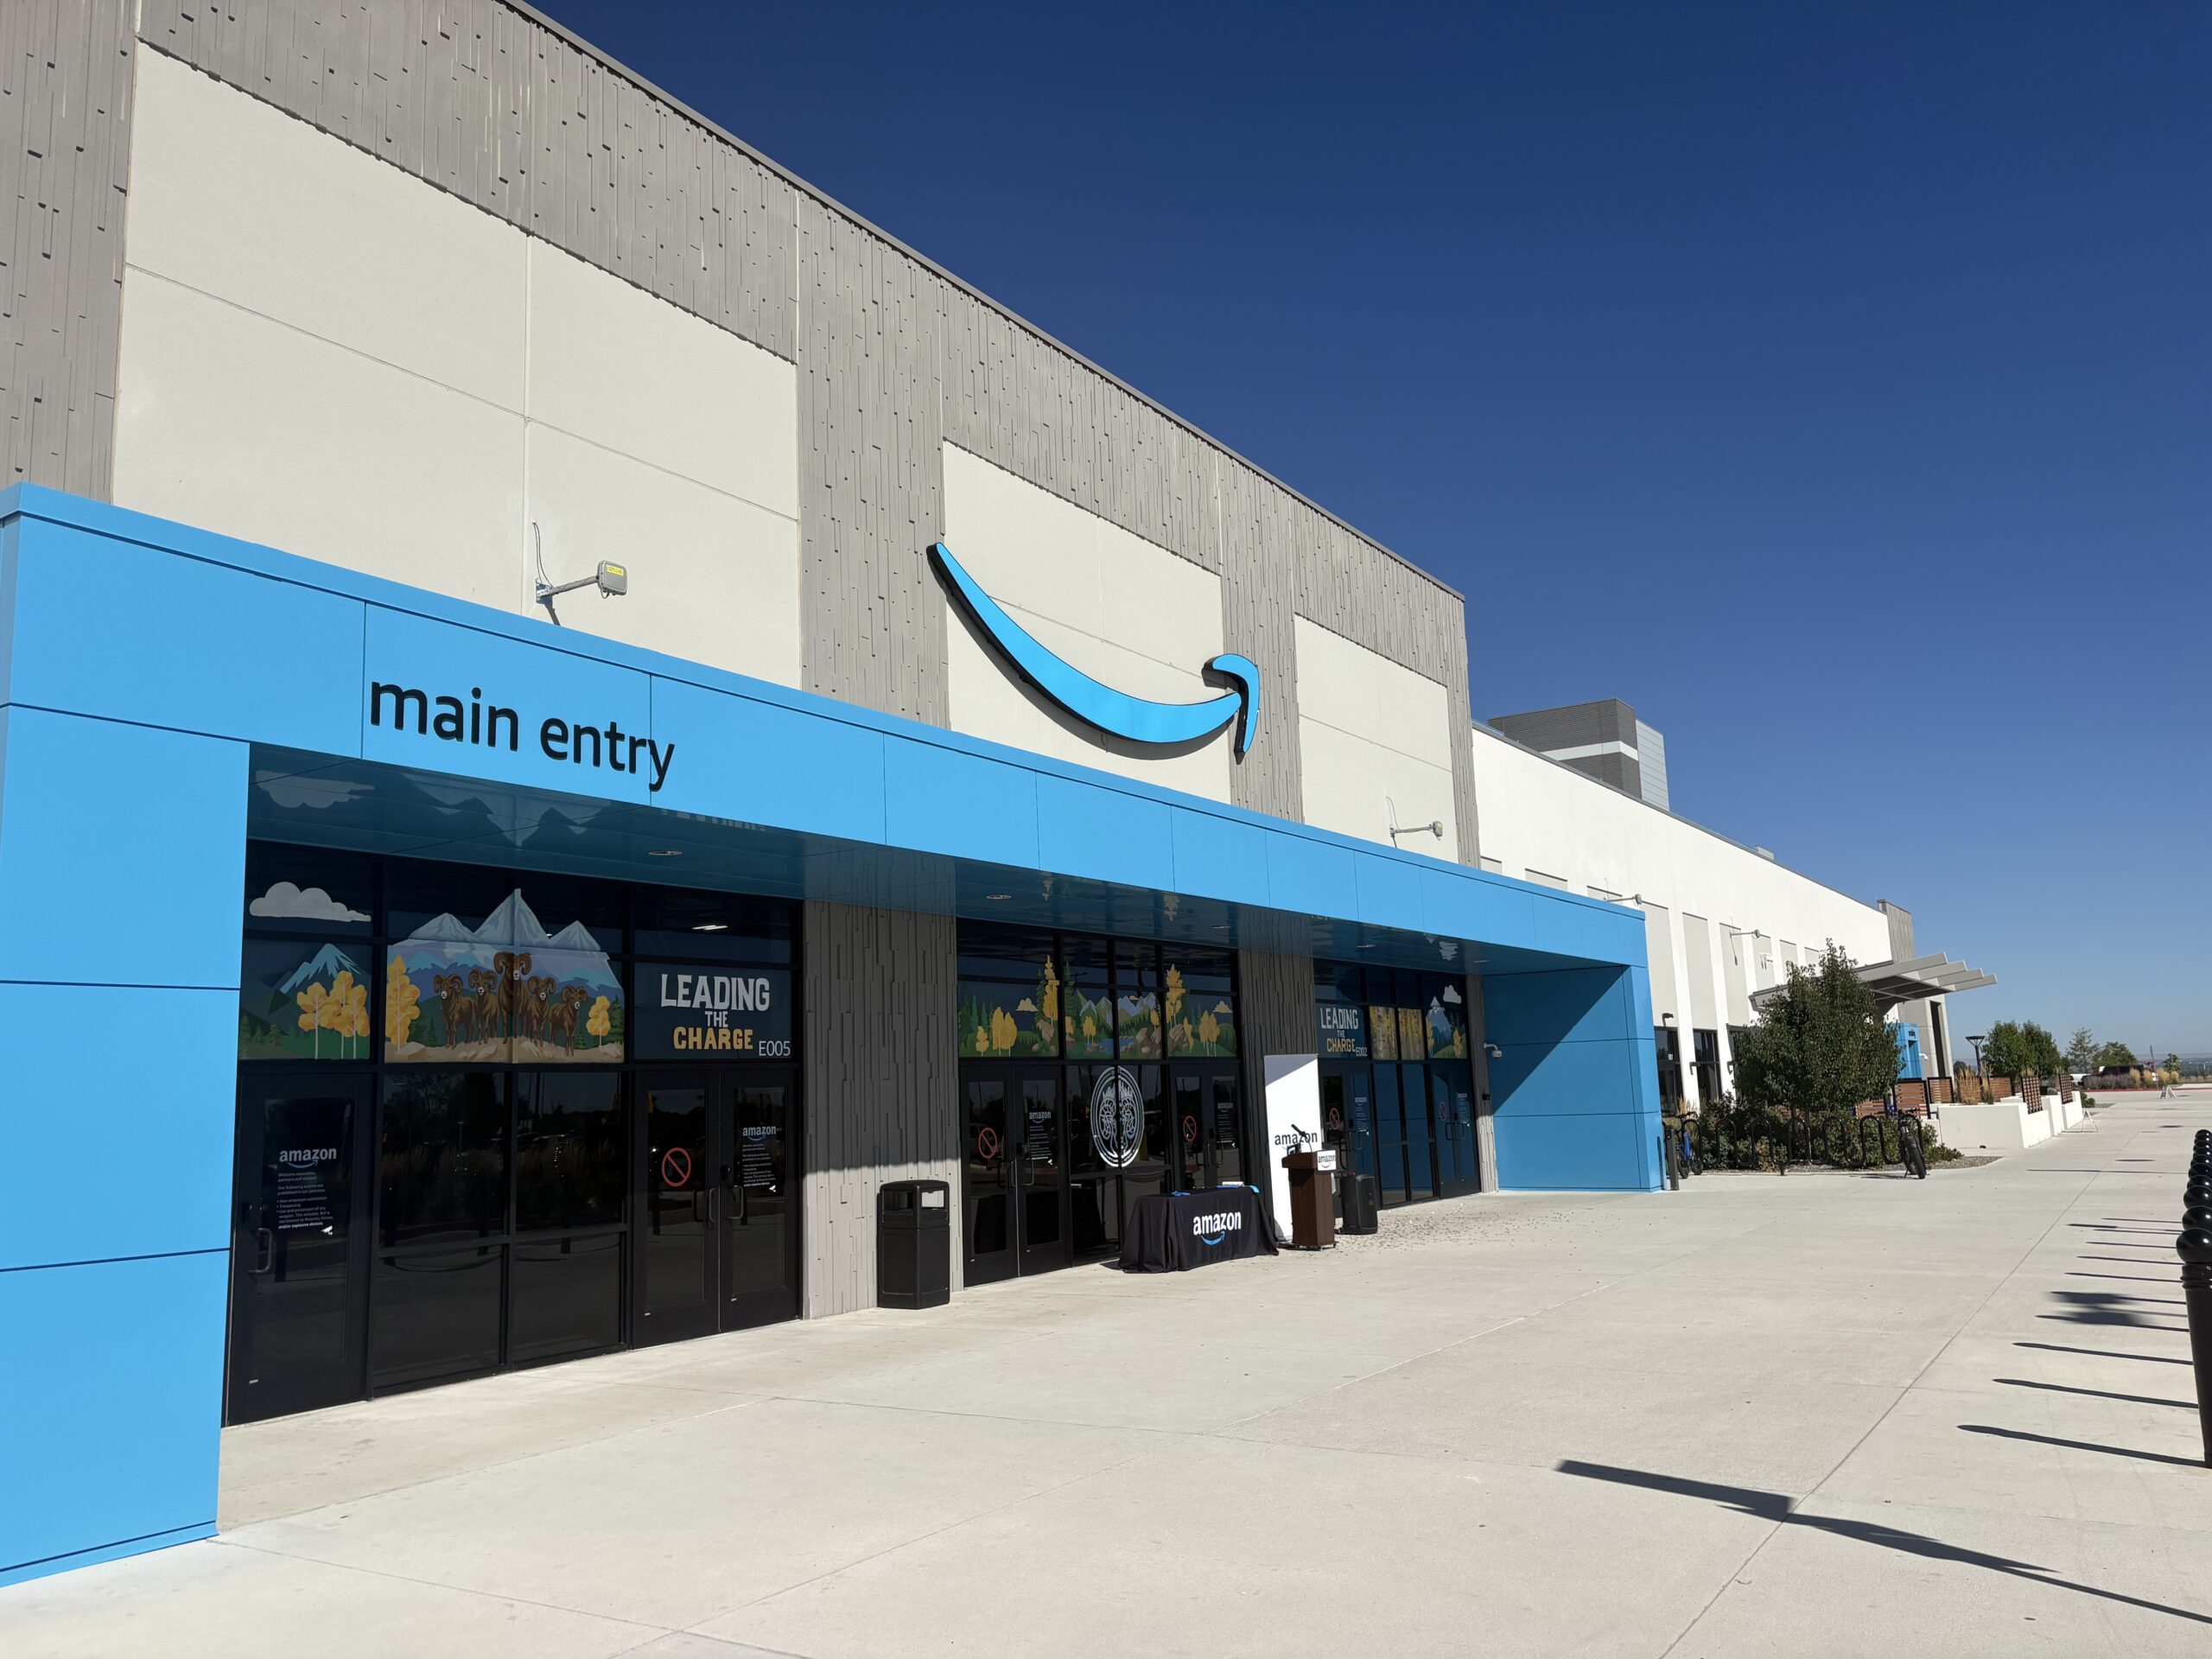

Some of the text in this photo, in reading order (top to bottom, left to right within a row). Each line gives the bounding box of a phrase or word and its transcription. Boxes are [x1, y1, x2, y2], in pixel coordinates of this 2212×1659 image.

[371, 681, 675, 792] main entry
[661, 974, 770, 1011] LEADING
[704, 1011, 728, 1028] THE
[1320, 1007, 1359, 1029] LEADING
[673, 1027, 753, 1050] CHARGE
[1337, 1029, 1345, 1038] THE
[759, 1040, 791, 1056] E005
[1326, 1038, 1356, 1052] CHARGE
[1356, 1046, 1368, 1057] E002
[1029, 1110, 1052, 1120] amazon
[742, 1126, 777, 1136] amazon
[1274, 1132, 1318, 1146] amazon
[279, 1147, 337, 1162] amazon
[1318, 1154, 1336, 1163] amazon
[1193, 1211, 1242, 1236] amazon
